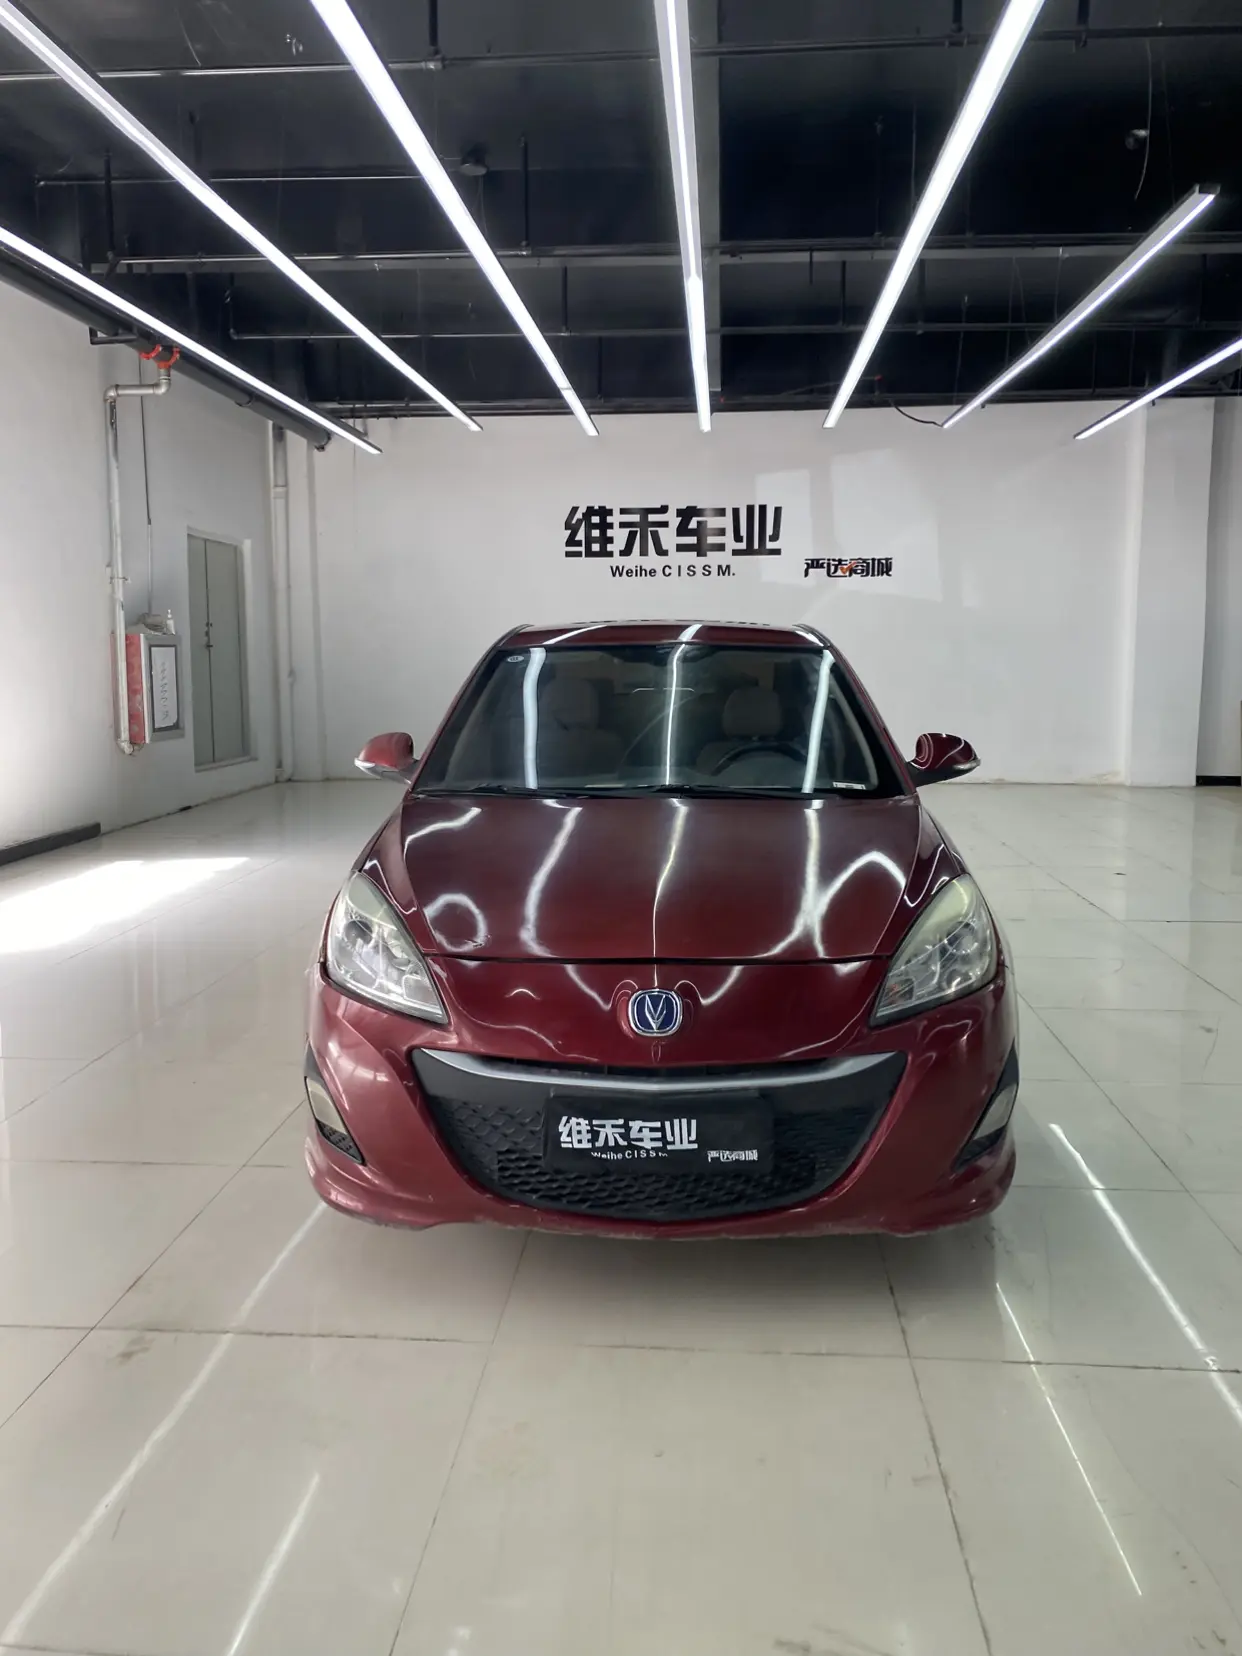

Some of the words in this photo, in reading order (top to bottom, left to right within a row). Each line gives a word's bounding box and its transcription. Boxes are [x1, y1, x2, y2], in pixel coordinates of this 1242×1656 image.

[564, 504, 783, 558] 维禾车业
[610, 564, 657, 578] Weihe
[804, 557, 893, 578] 严选商城
[558, 1115, 699, 1150] 维禾车业
